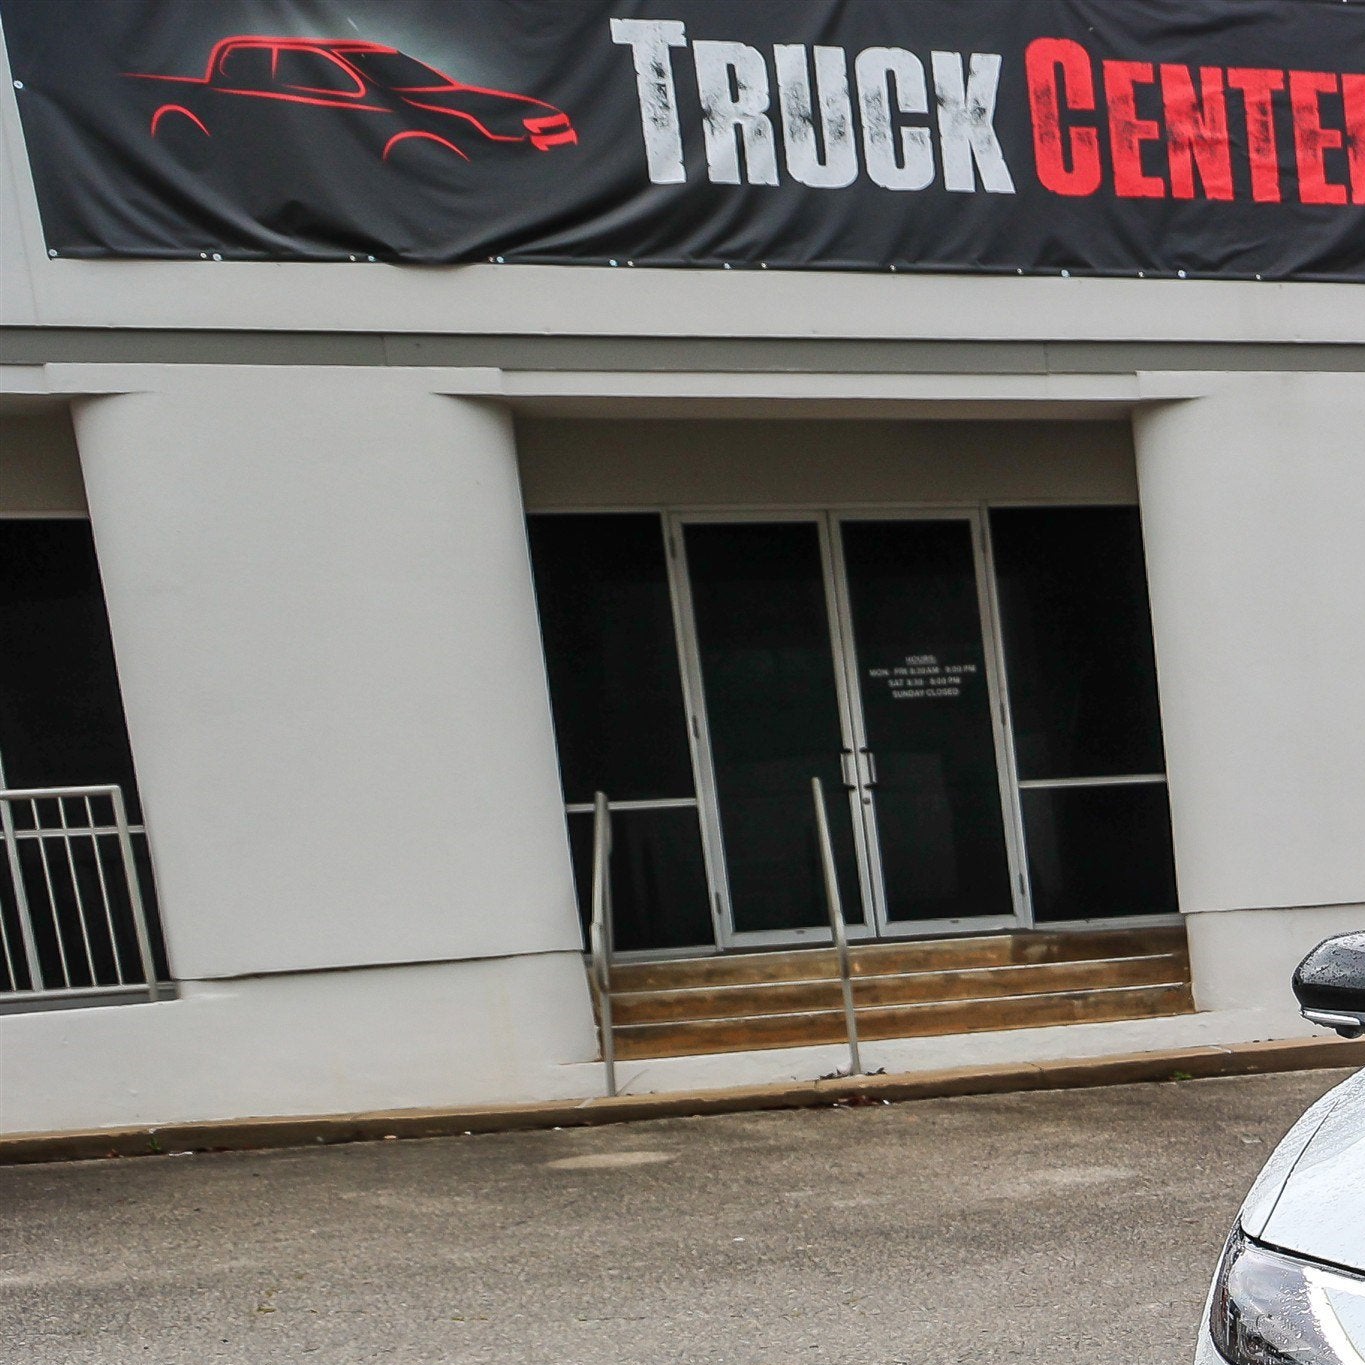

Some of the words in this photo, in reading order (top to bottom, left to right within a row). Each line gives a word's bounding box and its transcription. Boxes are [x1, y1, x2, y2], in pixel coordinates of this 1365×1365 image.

[611, 18, 1015, 194] TRUCK
[892, 689, 924, 699] SUNDAY
[925, 687, 960, 697] CLOSED
